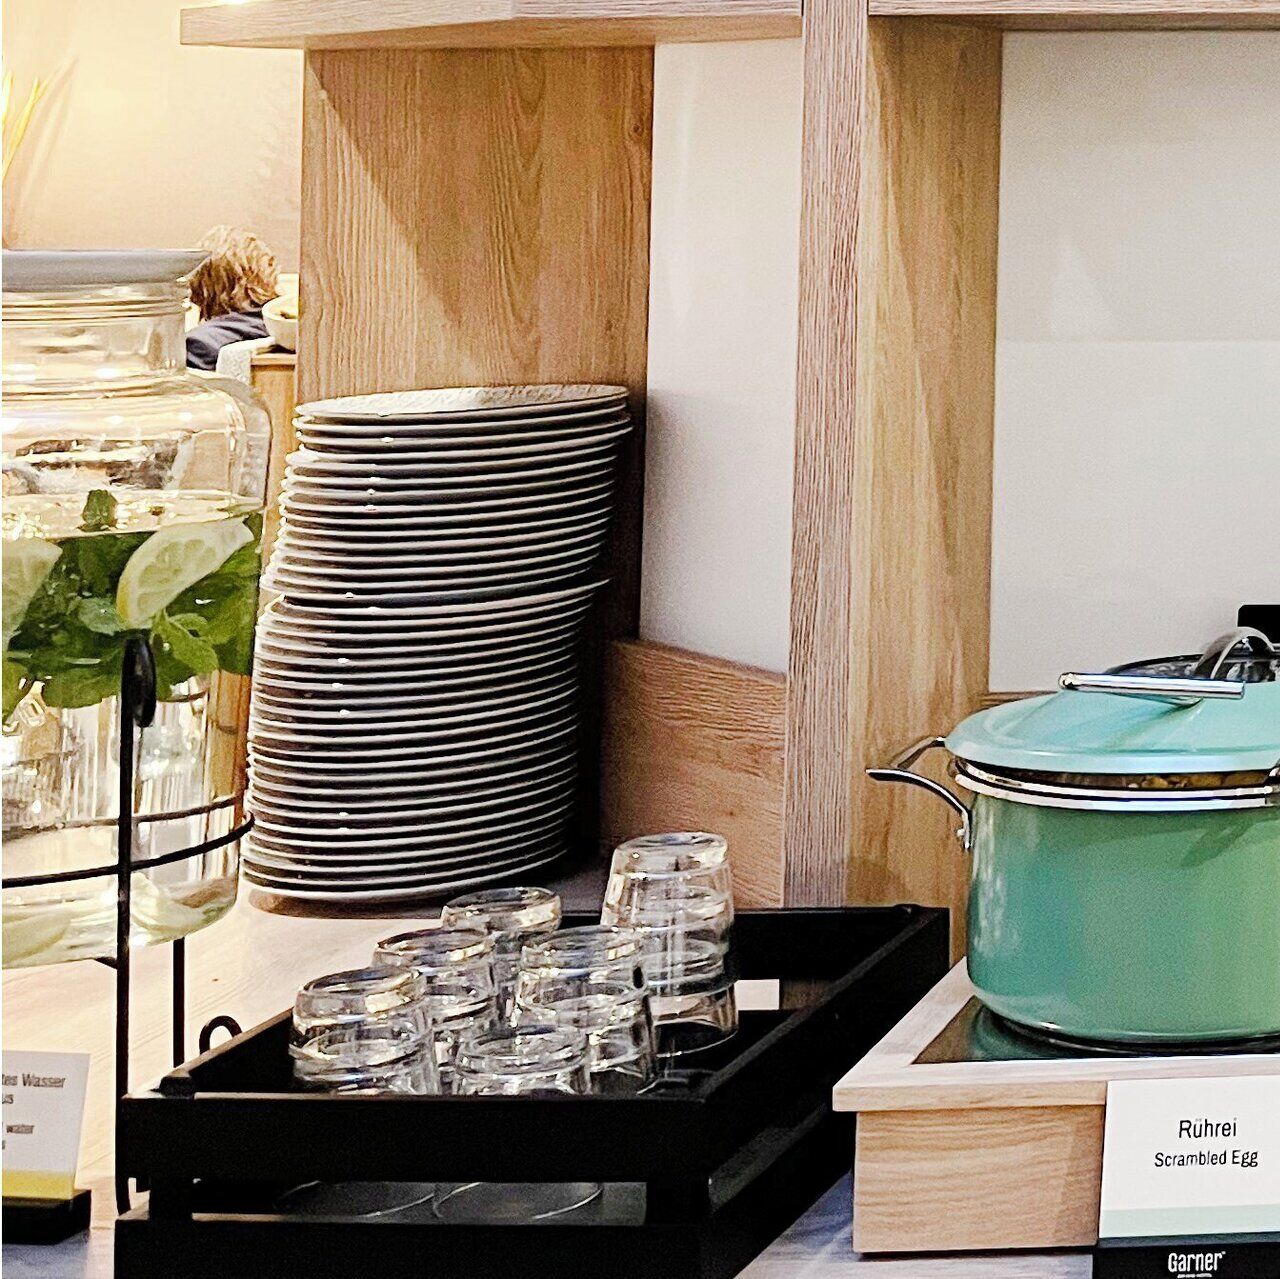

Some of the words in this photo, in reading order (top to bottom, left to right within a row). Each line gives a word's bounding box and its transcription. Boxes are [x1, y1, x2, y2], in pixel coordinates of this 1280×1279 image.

[1178, 1117, 1237, 1139] Rührei
[1154, 1150, 1227, 1168] Scrambled
[1232, 1149, 1259, 1167] Egg
[1168, 1251, 1223, 1272] Garner
